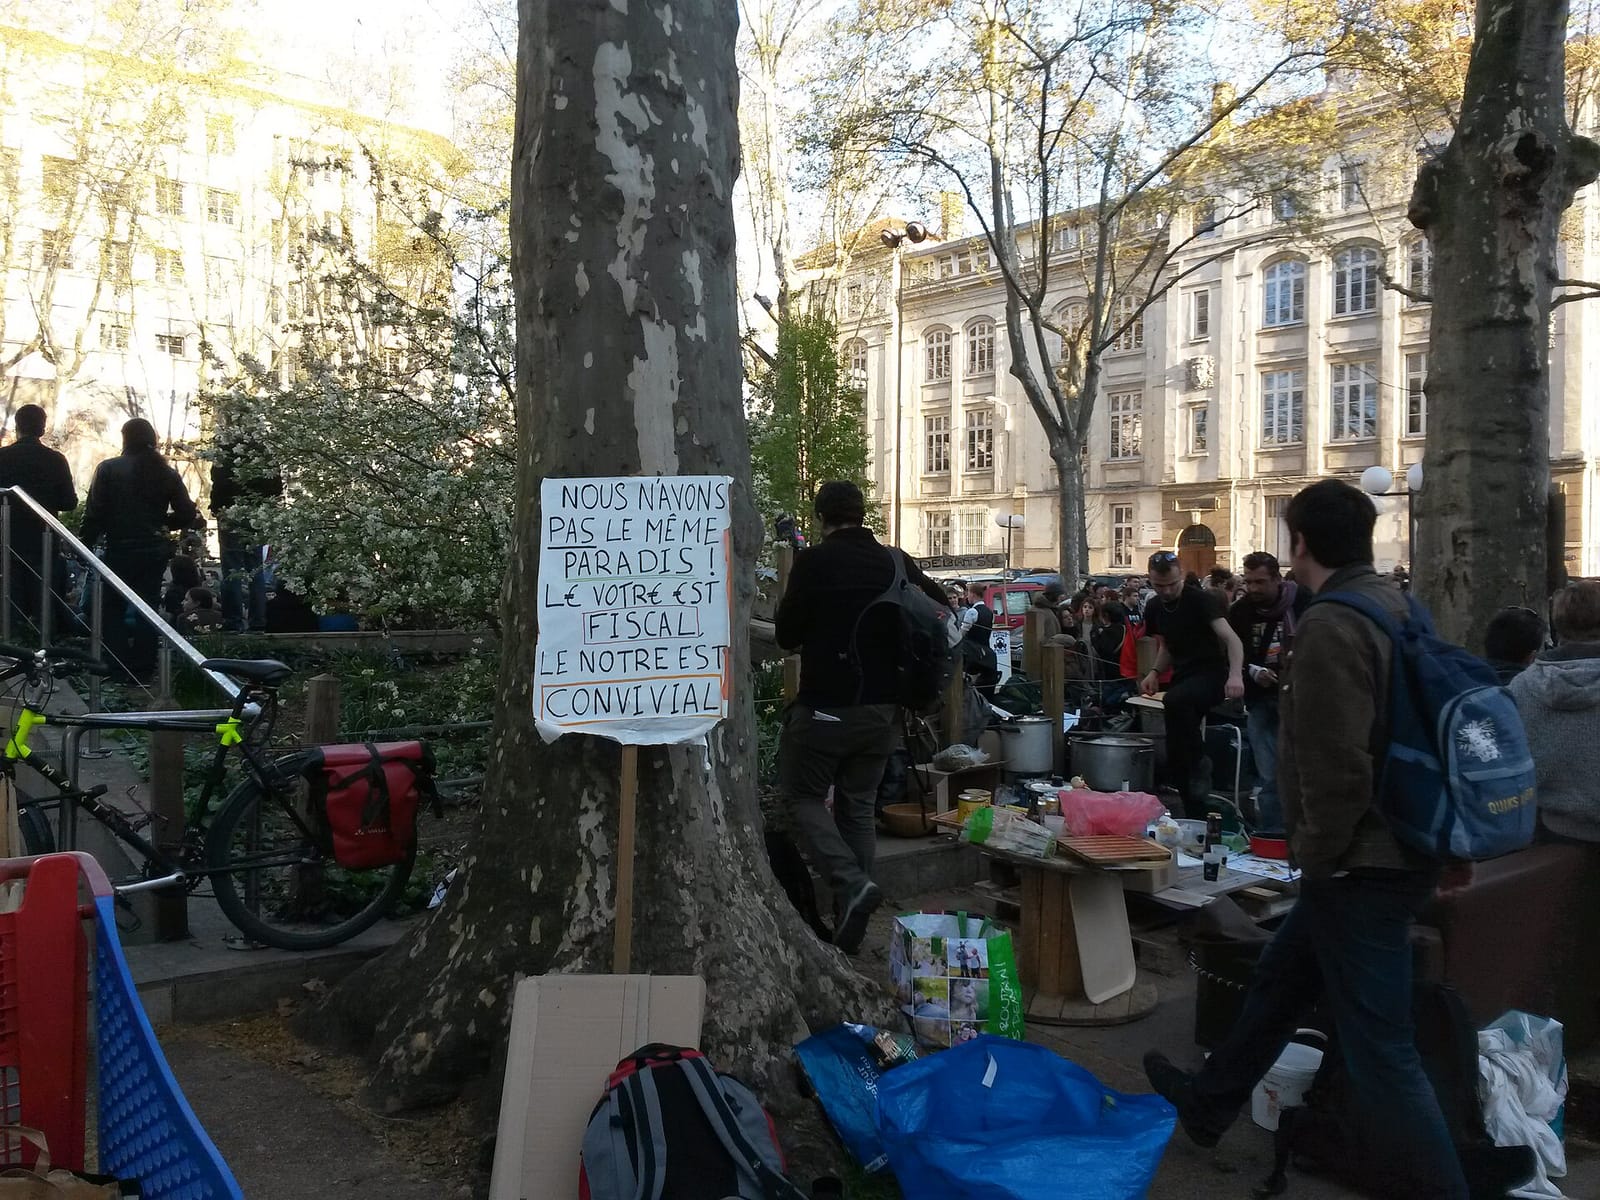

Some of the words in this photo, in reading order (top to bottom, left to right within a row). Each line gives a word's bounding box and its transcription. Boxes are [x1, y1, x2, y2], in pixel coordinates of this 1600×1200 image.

[562, 482, 628, 510] NOUS
[639, 478, 726, 511] N'AVONS
[549, 516, 595, 544] PAS
[606, 517, 632, 542] LE
[646, 513, 719, 545] MÊME
[565, 547, 694, 578] PARADIS
[540, 650, 568, 675] LE
[580, 648, 669, 674] NOTRE
[679, 645, 728, 670] EST
[546, 682, 719, 717] CONVIVIAL
